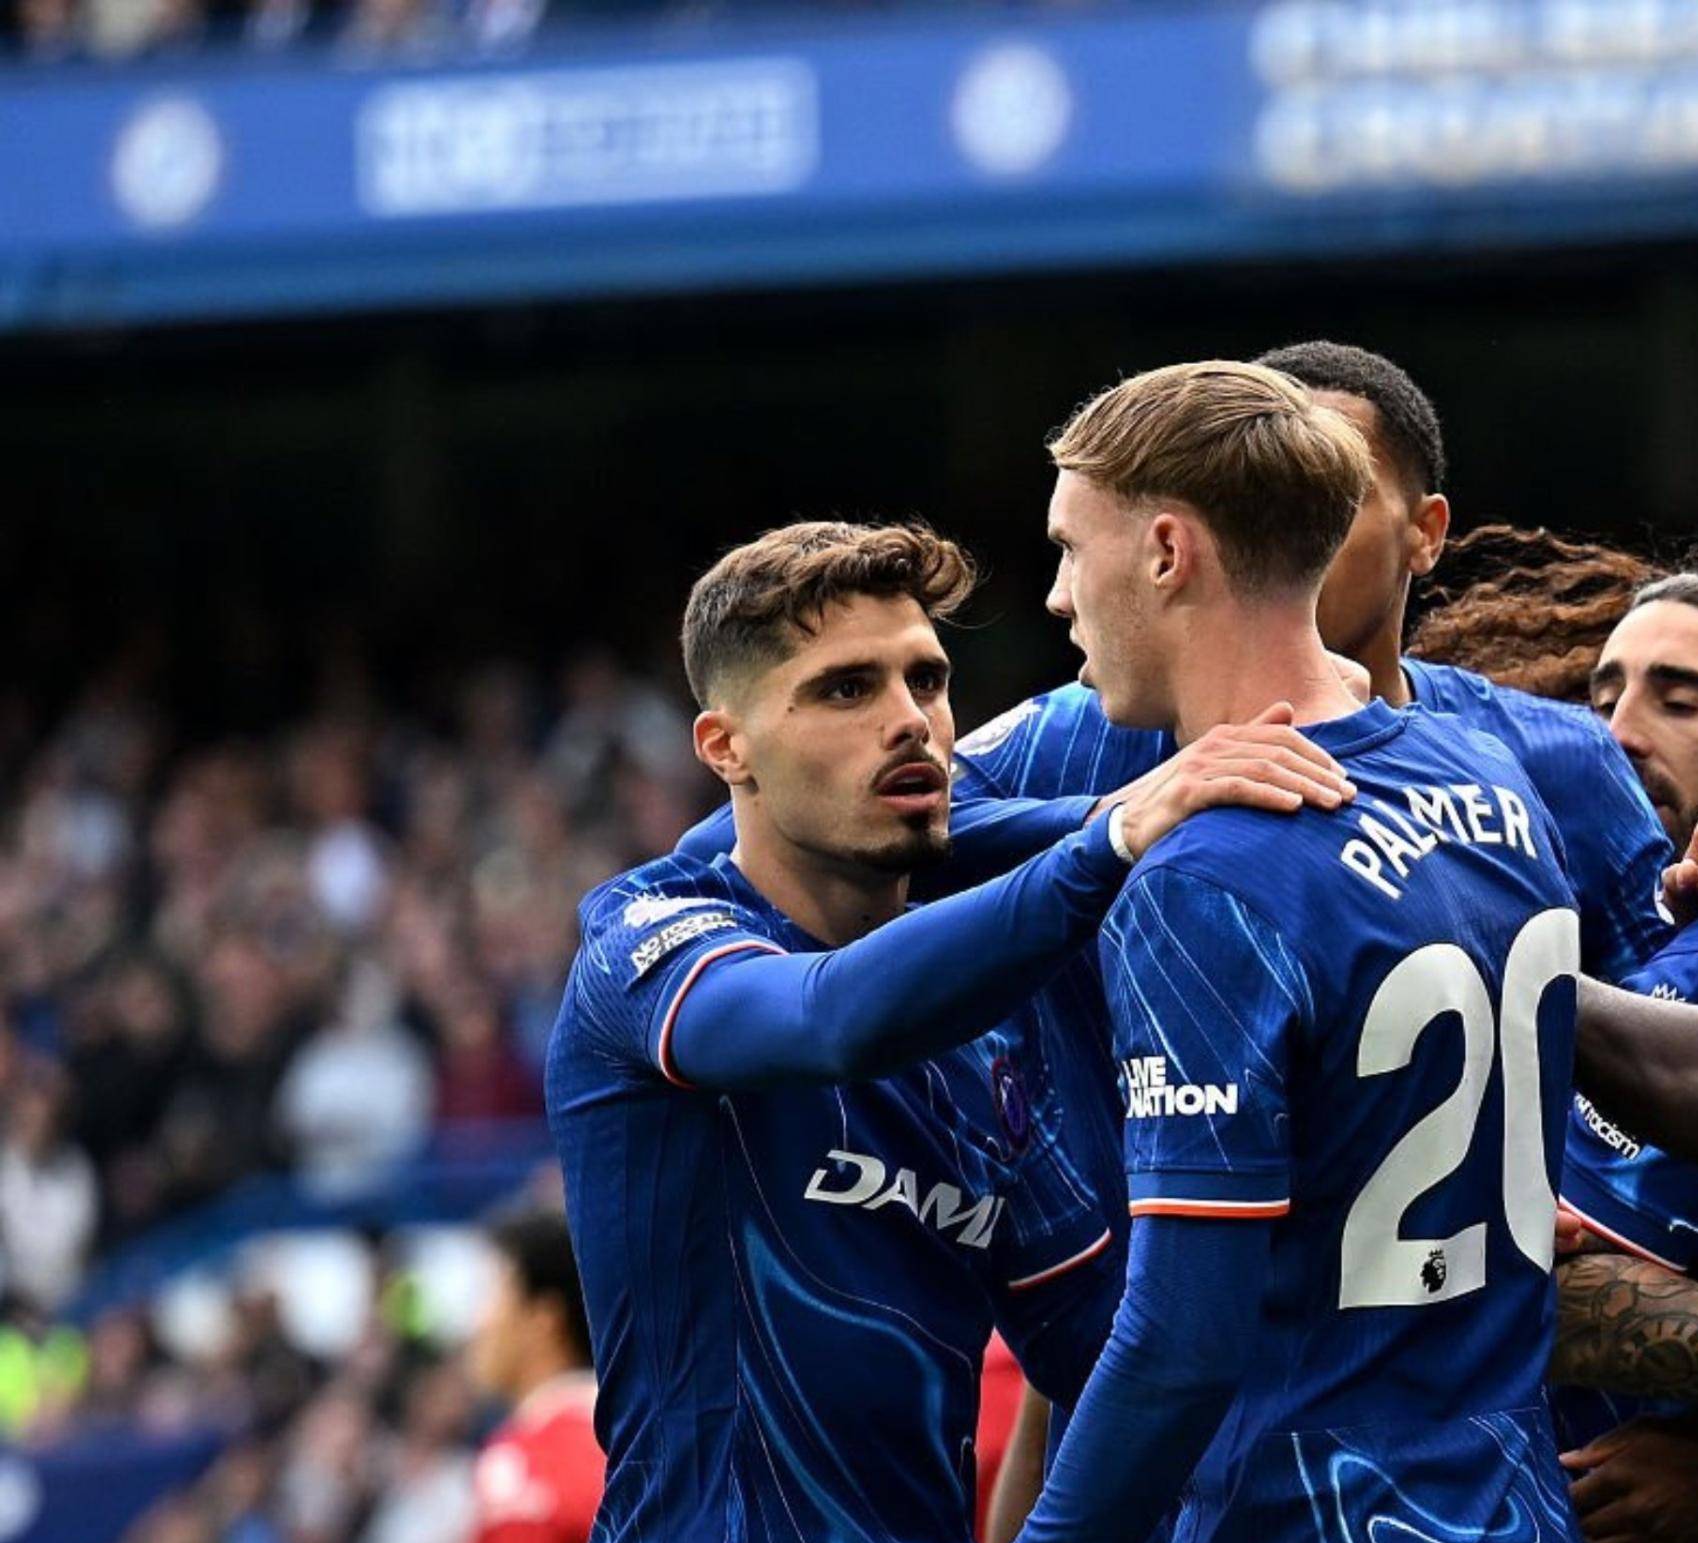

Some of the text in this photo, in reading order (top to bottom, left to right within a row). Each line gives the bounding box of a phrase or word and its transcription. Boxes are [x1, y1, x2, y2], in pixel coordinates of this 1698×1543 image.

[1341, 784, 1537, 899] PALMER
[1122, 1056, 1166, 1088] LIVE
[1126, 1083, 1238, 1118] NATION
[1339, 908, 1580, 1310] 20
[804, 1149, 1005, 1249] DAM
